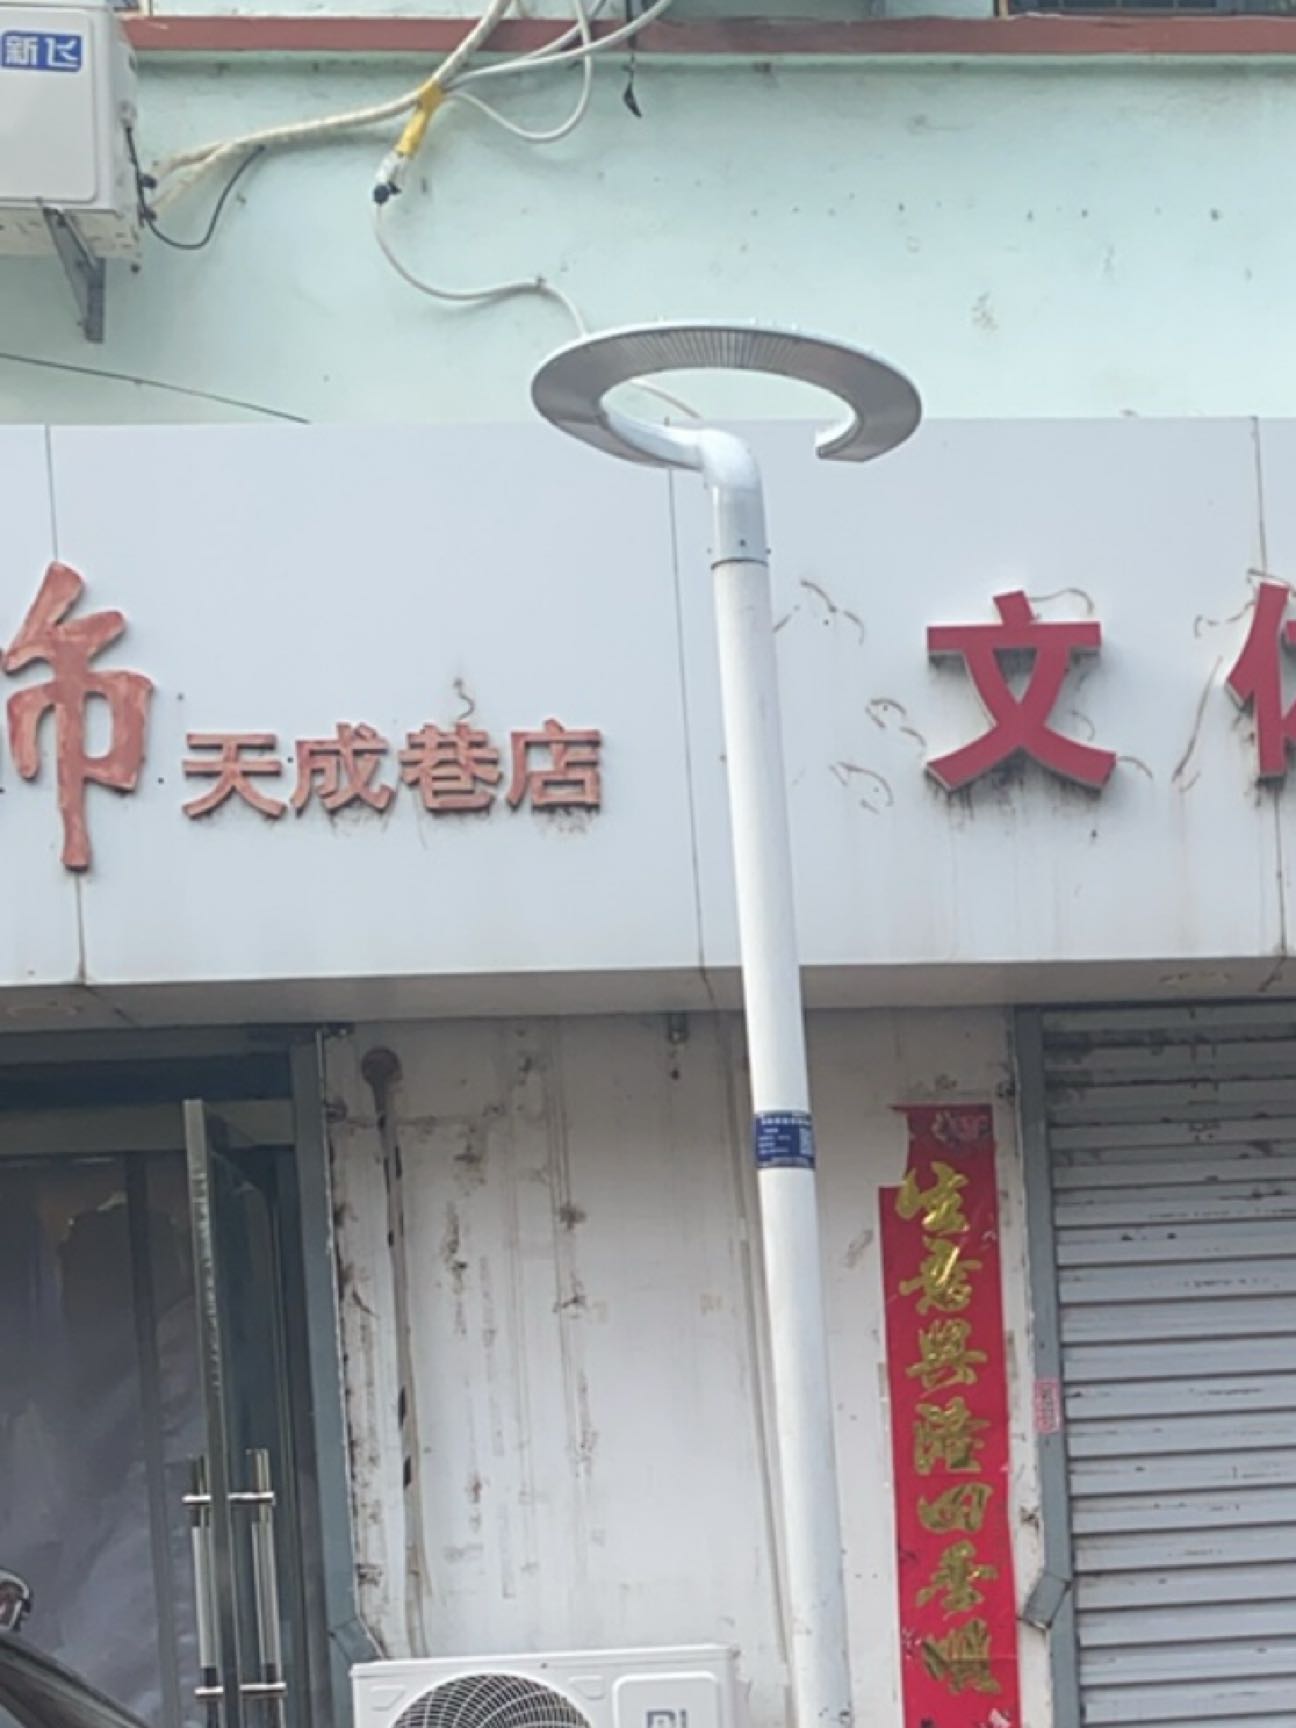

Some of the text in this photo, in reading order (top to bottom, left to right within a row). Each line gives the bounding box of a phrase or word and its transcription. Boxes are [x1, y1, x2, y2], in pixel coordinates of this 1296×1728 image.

[5, 35, 80, 68] 新飞
[181, 718, 604, 820] 天成巷店
